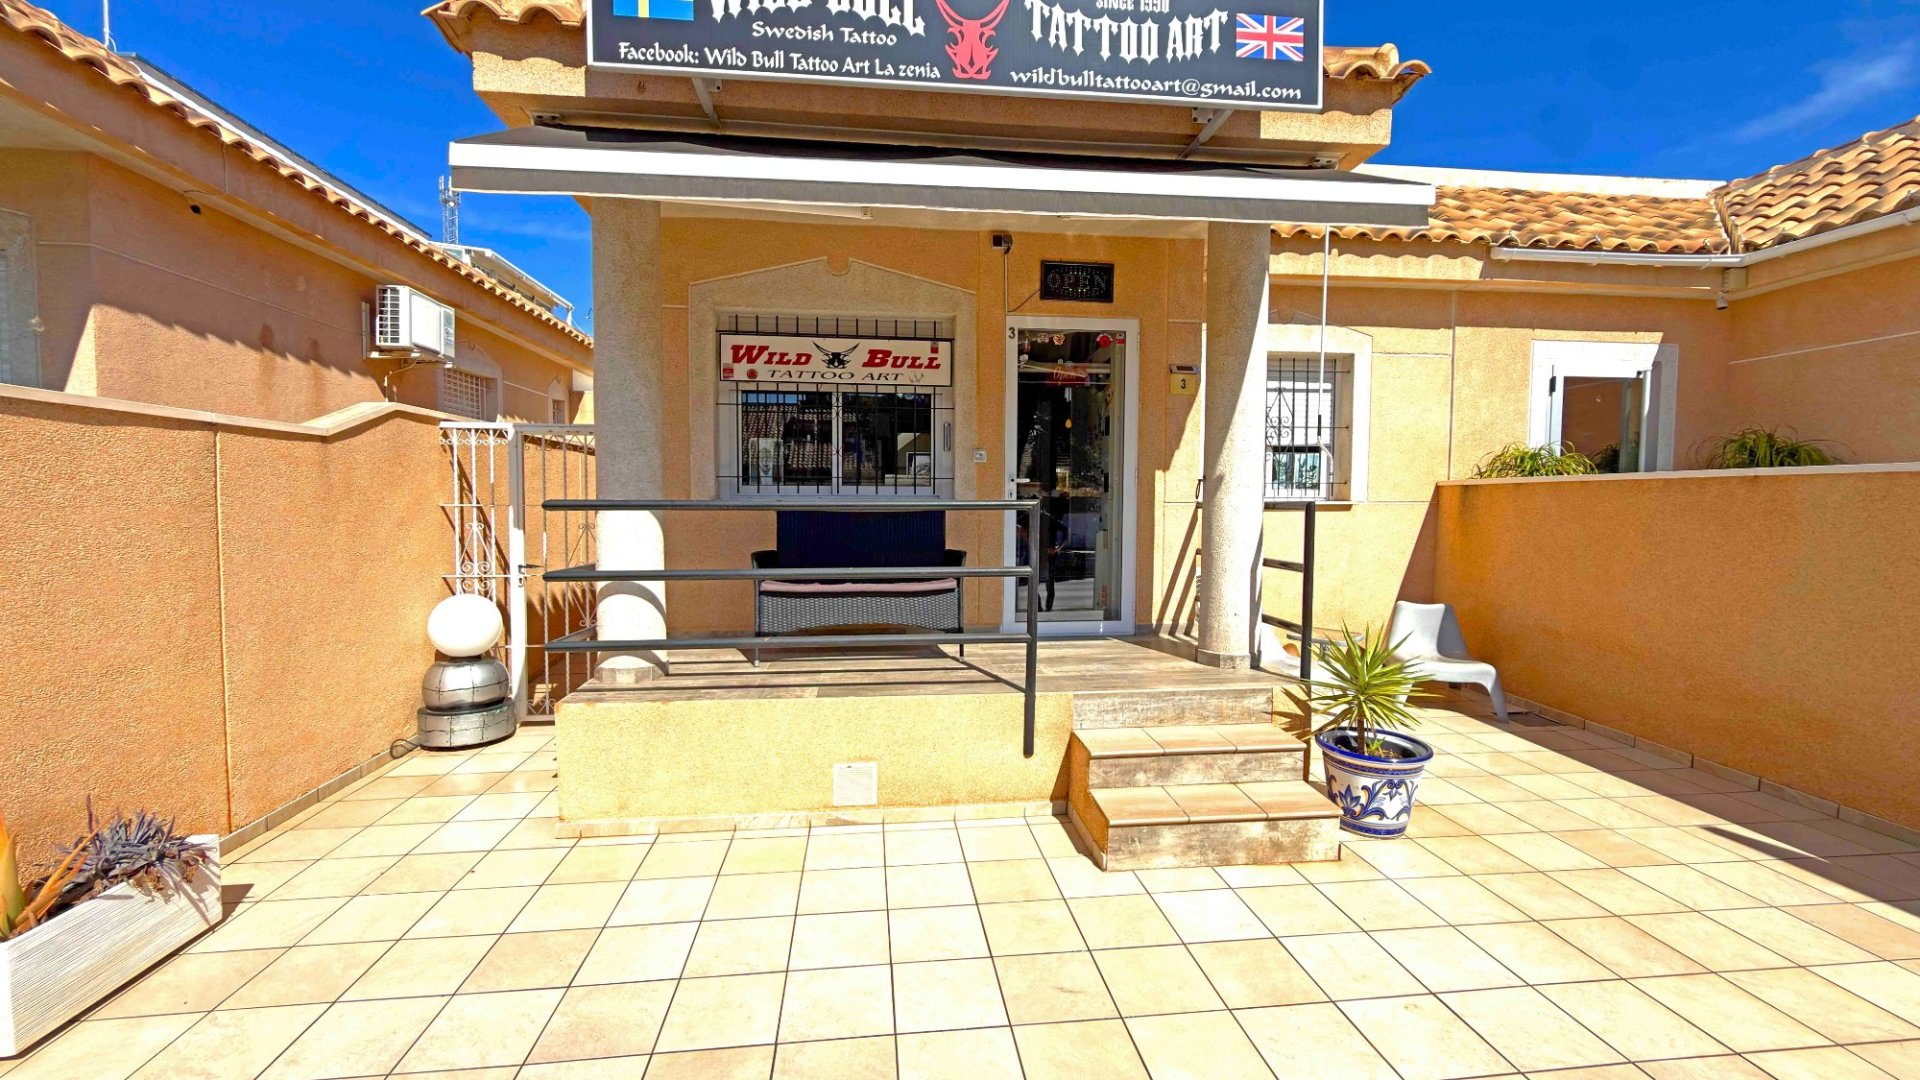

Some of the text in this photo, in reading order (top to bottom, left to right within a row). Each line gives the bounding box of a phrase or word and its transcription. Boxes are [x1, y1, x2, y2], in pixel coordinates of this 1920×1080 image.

[752, 21, 898, 46] Swedish Tattoo
[1024, 0, 1229, 64] TATTOO ART
[618, 42, 941, 80] Facebook: Wild Bull Tattoo Art La zenia
[1009, 67, 1302, 100] wildbulltattooart@gmail.com
[1047, 270, 1107, 291] OPEN
[1008, 327, 1016, 340] 3
[730, 344, 942, 370] WILD BULL
[768, 369, 855, 381] TATTOO
[862, 372, 904, 382] ART
[1181, 379, 1187, 389] 3
